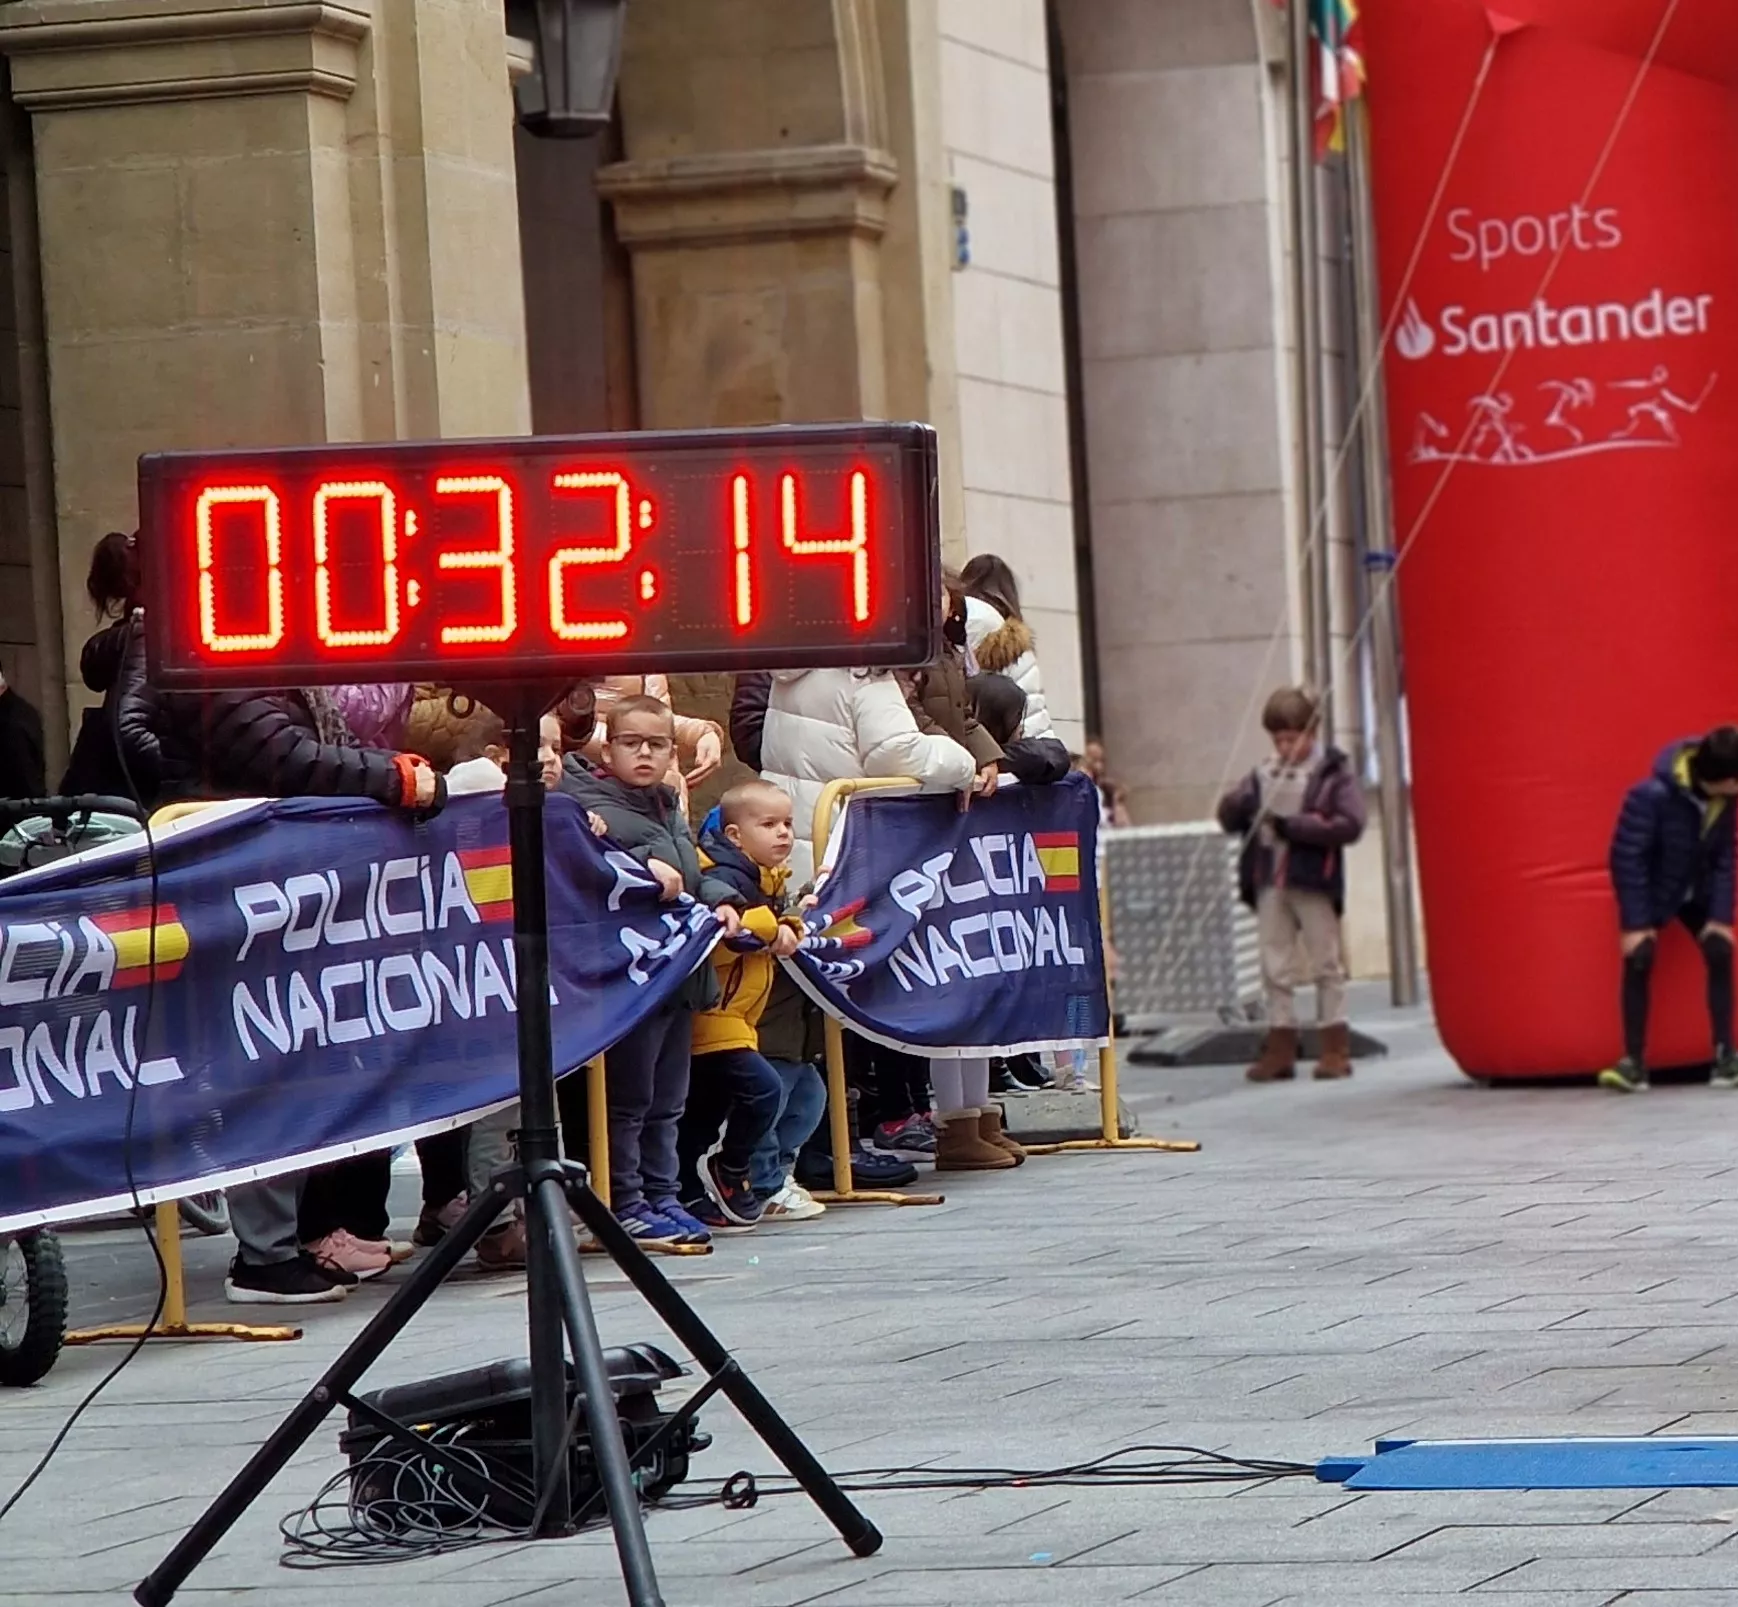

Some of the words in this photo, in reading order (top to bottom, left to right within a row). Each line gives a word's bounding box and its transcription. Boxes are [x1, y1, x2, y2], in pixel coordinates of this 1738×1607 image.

[1446, 203, 1622, 273] Sports
[1440, 288, 1714, 356] Santander
[197, 469, 870, 653] 00:32:14
